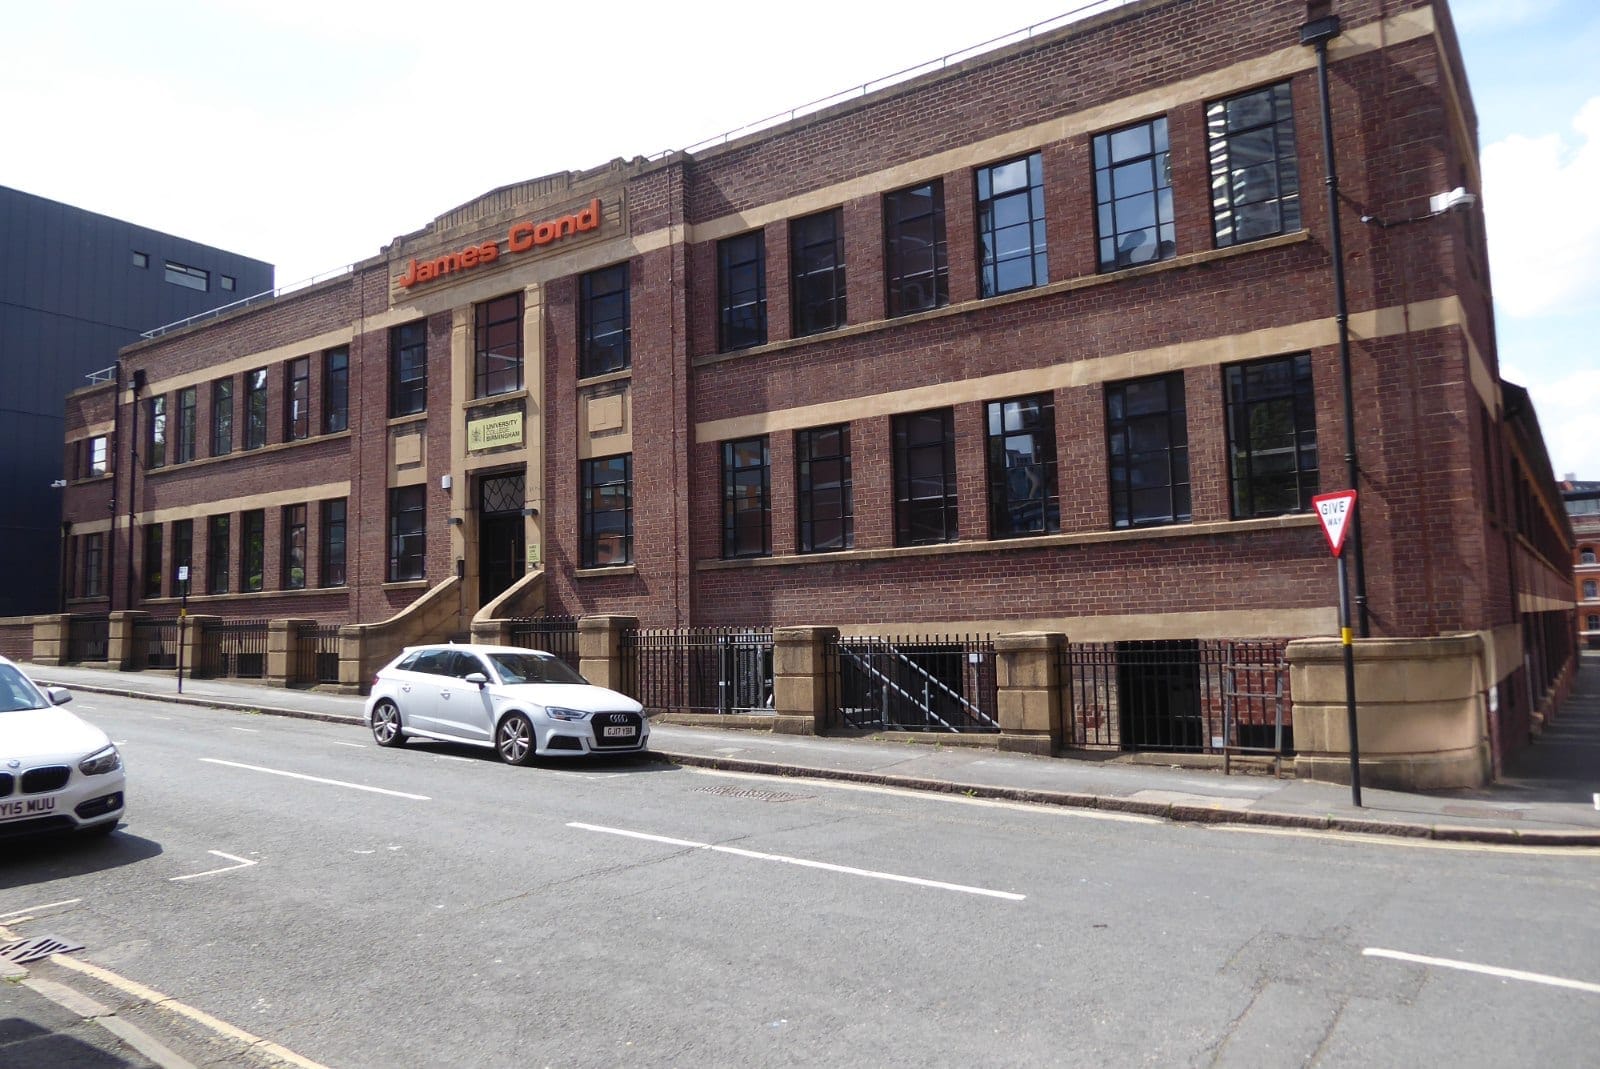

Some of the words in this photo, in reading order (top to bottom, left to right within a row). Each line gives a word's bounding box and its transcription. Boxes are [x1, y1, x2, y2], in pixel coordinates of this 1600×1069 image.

[400, 240, 498, 288] James
[508, 198, 601, 253] Cond
[486, 419, 518, 430] UNIVERSITY
[486, 431, 520, 442] BIRMINGHAM
[1321, 501, 1345, 515] GIVE
[1327, 517, 1342, 526] WAY
[27, 796, 55, 812] MUU
